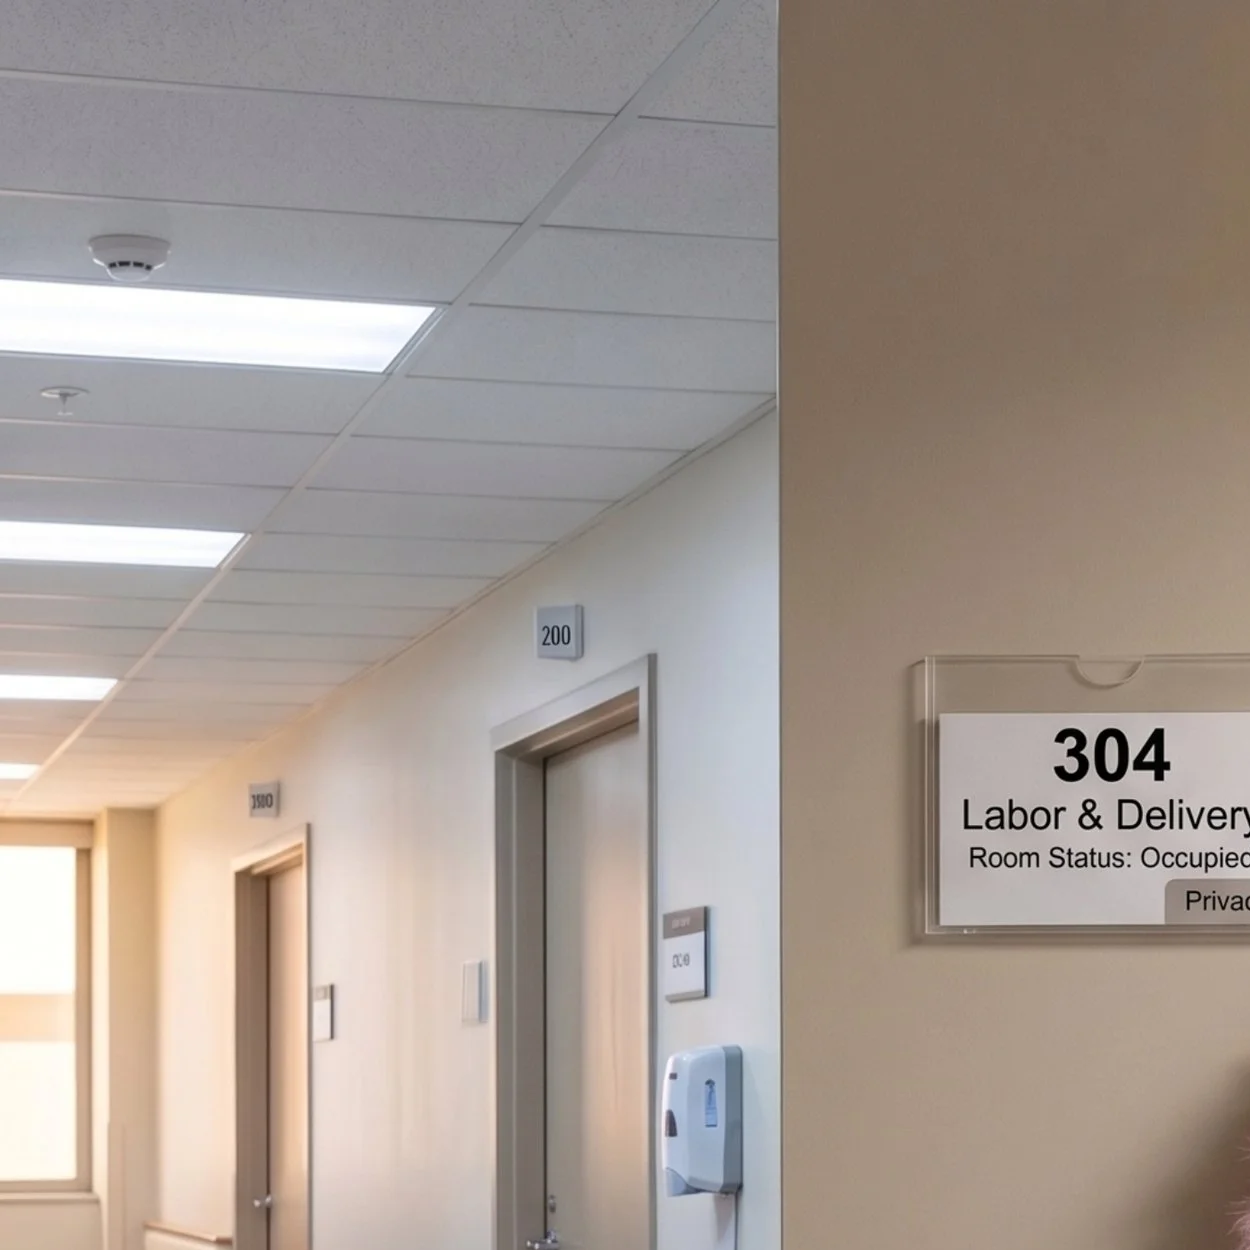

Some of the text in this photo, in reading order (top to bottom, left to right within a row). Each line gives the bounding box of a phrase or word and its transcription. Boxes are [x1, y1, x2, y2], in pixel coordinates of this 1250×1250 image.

[542, 625, 570, 645] 200
[1054, 728, 1170, 782] 304
[964, 799, 1066, 830] Labor
[1078, 799, 1103, 830] &
[970, 847, 1039, 868] Room
[1049, 847, 1131, 868] Status:
